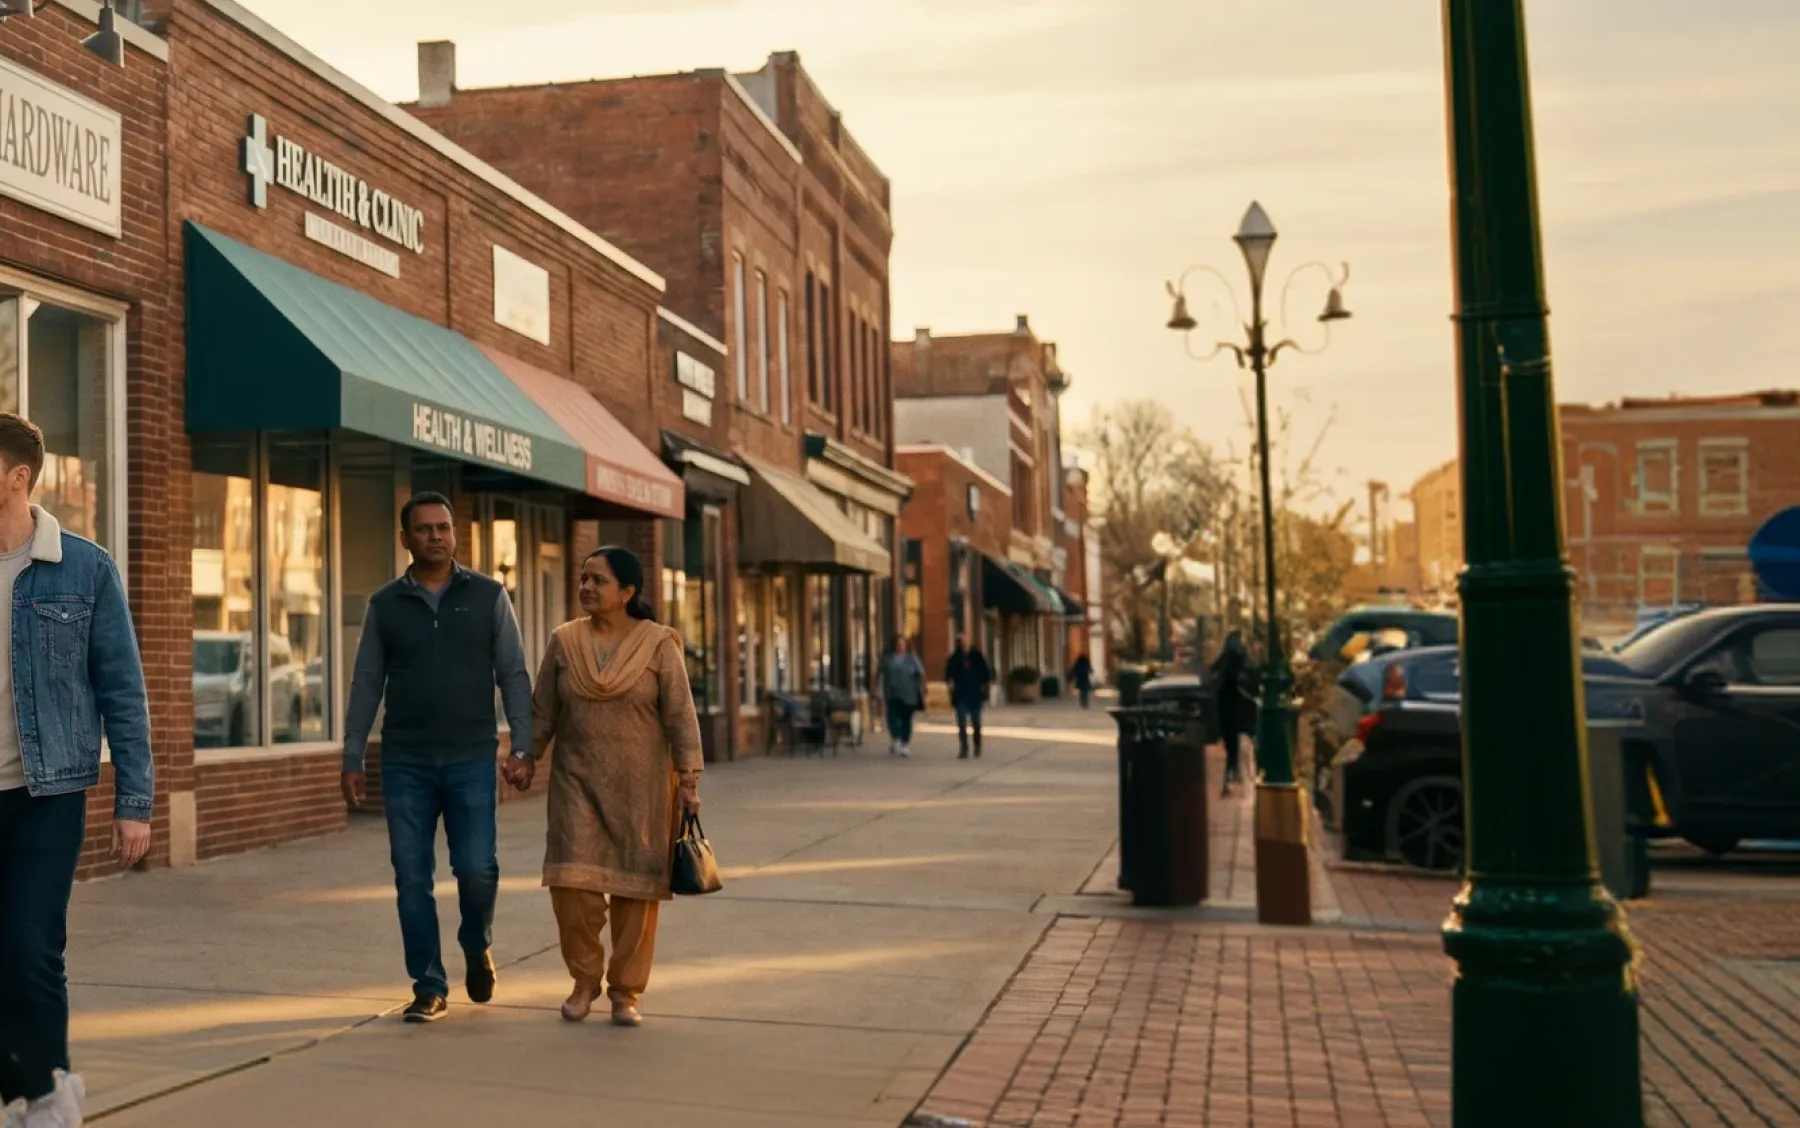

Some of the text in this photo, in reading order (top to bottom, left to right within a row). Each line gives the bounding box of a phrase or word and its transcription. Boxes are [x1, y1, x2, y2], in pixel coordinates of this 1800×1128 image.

[357, 180, 371, 229] &
[372, 189, 424, 254] CLINIC
[413, 402, 532, 472] HEALTH & WELLNESS
